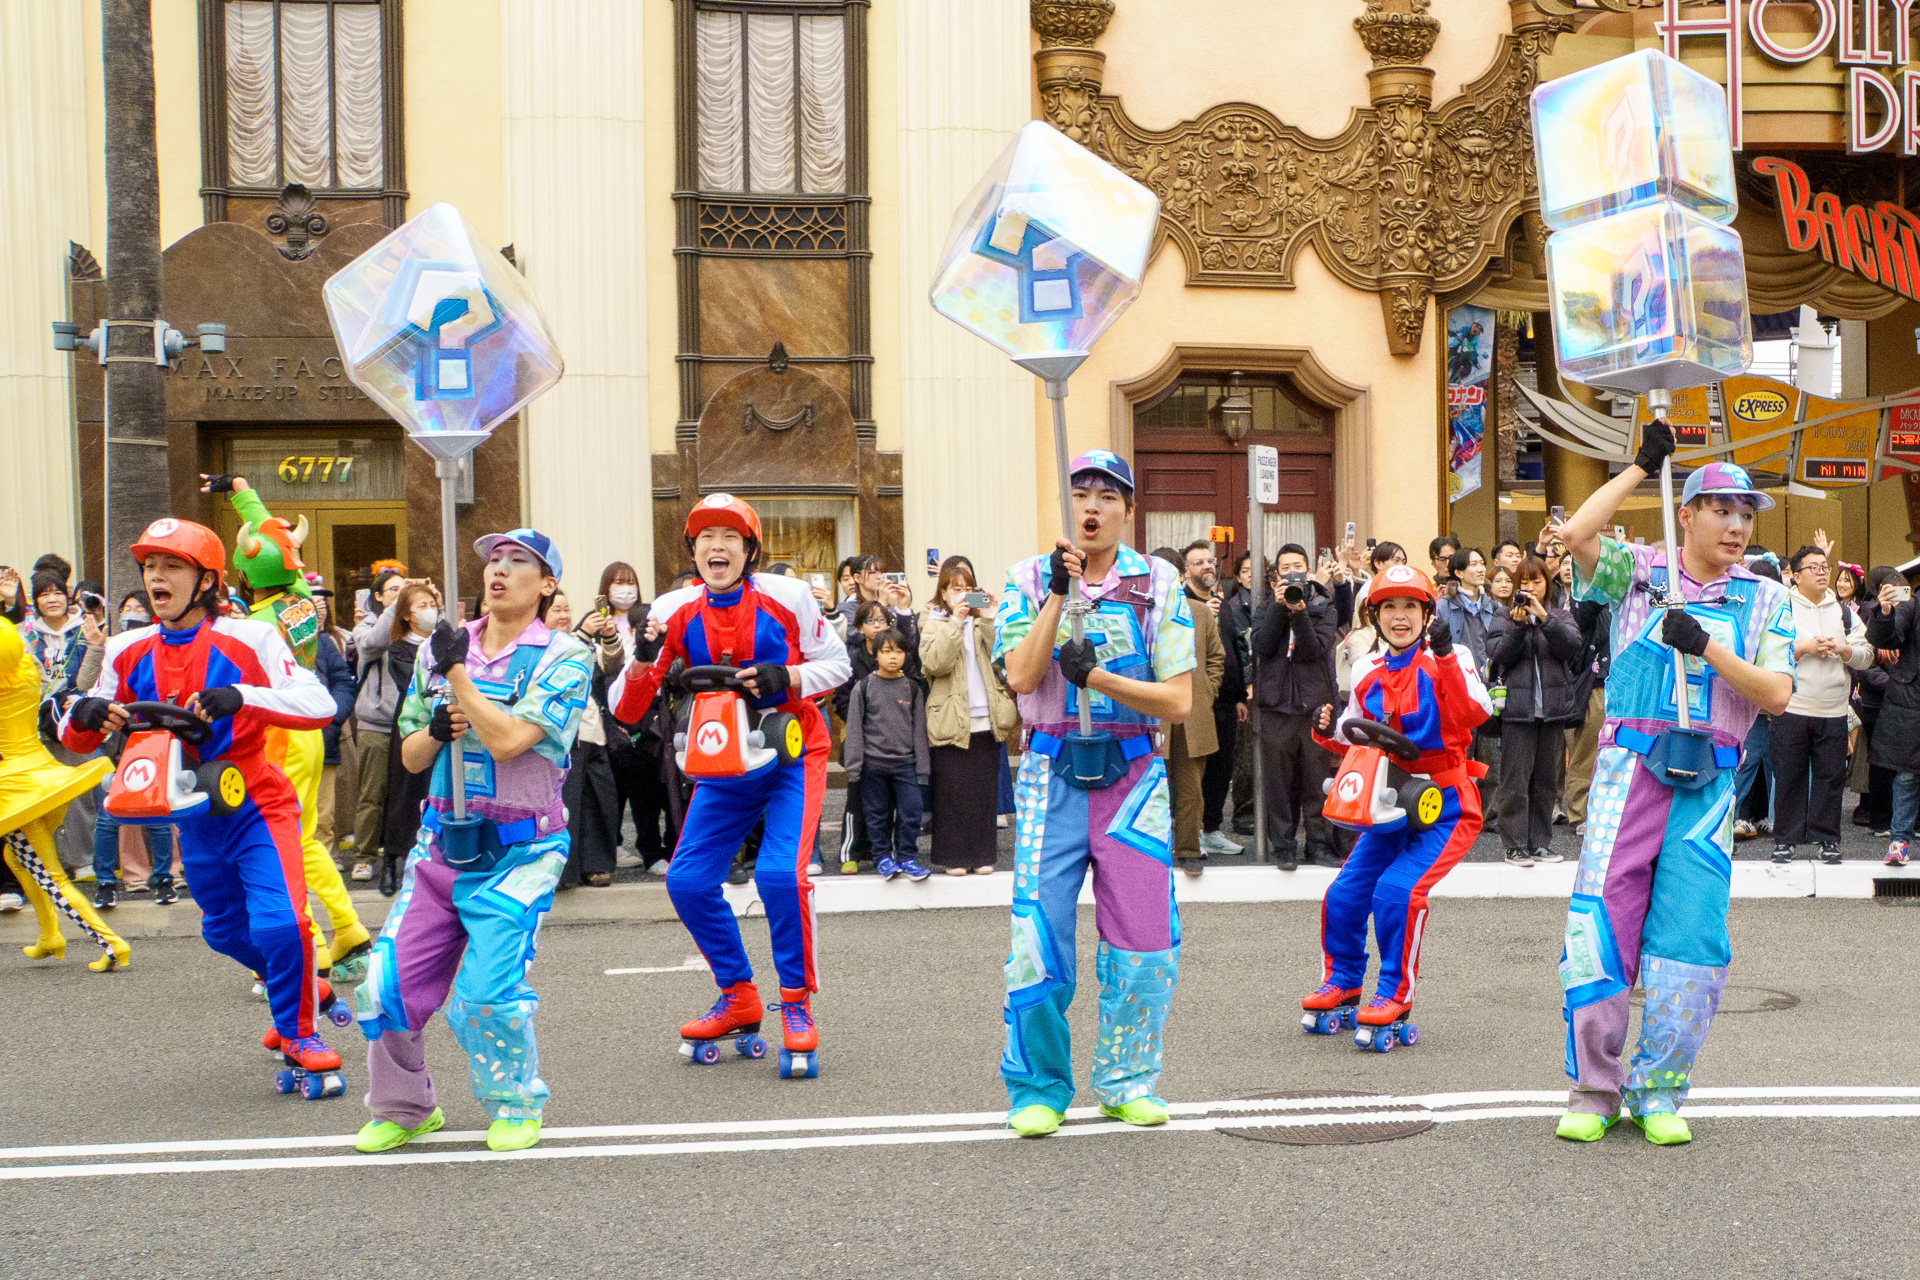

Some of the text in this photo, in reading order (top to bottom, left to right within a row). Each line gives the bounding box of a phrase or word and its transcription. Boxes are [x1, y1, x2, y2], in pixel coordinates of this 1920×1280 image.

[166, 356, 244, 379] MAX
[1738, 399, 1784, 418] EXPRESS
[1813, 425, 1871, 440] HOLLYWOOD
[1257, 455, 1277, 467] PASSENGER
[278, 456, 353, 483] 6777
[1260, 469, 1275, 480] LOADING
[1263, 482, 1271, 493] ONLY
